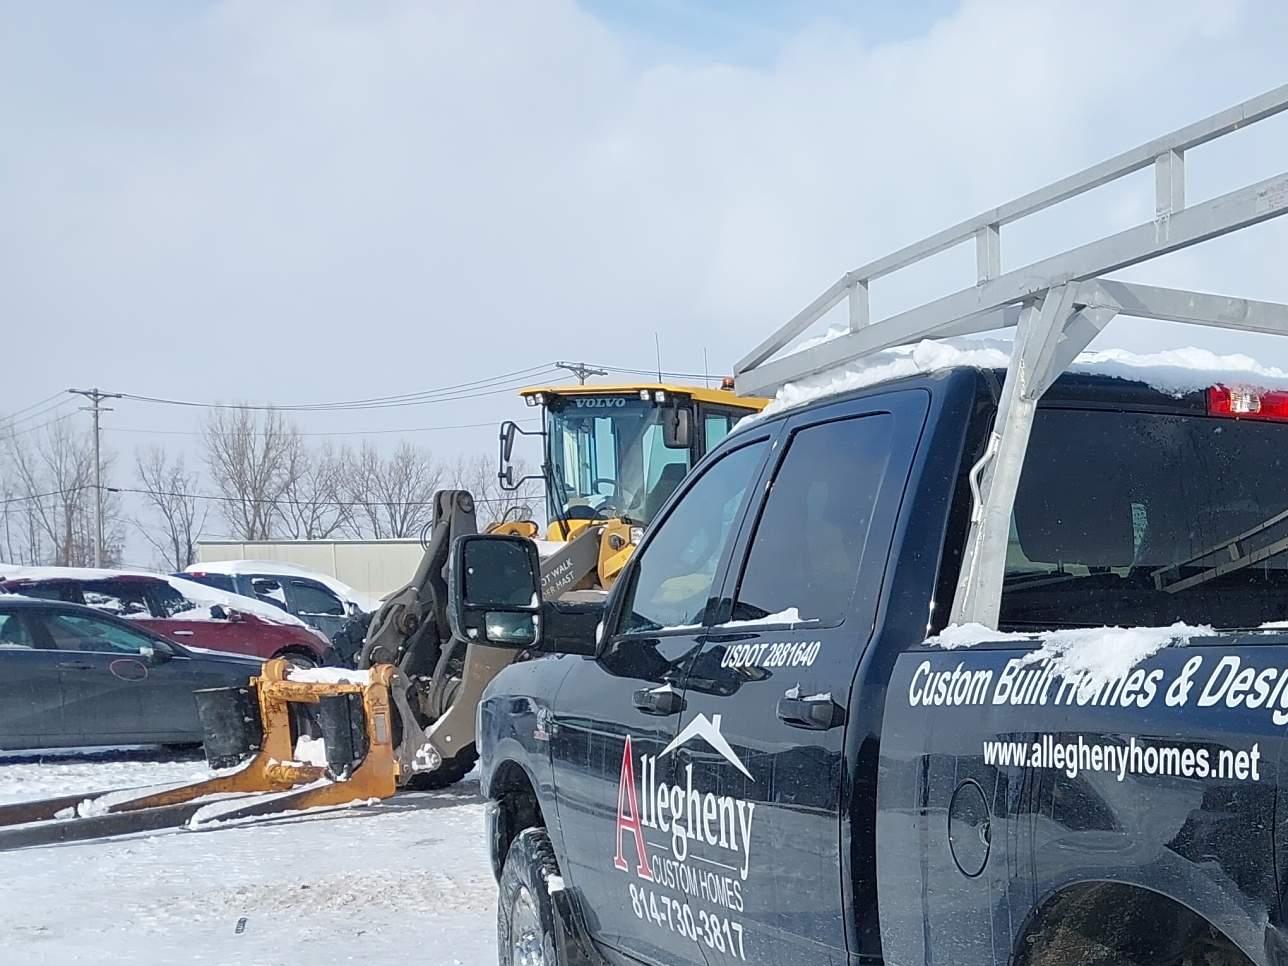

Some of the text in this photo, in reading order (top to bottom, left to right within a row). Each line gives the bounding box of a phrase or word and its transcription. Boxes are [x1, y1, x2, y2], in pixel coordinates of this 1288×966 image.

[575, 398, 626, 408] VOLVO
[551, 558, 574, 577] WALK
[556, 571, 575, 590] MAST
[721, 641, 821, 668] USDOT 2881640
[909, 660, 993, 706] Custom
[1165, 656, 1203, 707] &
[983, 735, 1260, 782] www.alleghenyhomes.net
[614, 735, 755, 881] Allegheny
[652, 855, 744, 912] CUSTOM HOMES
[629, 883, 746, 961] 814-730-3817
